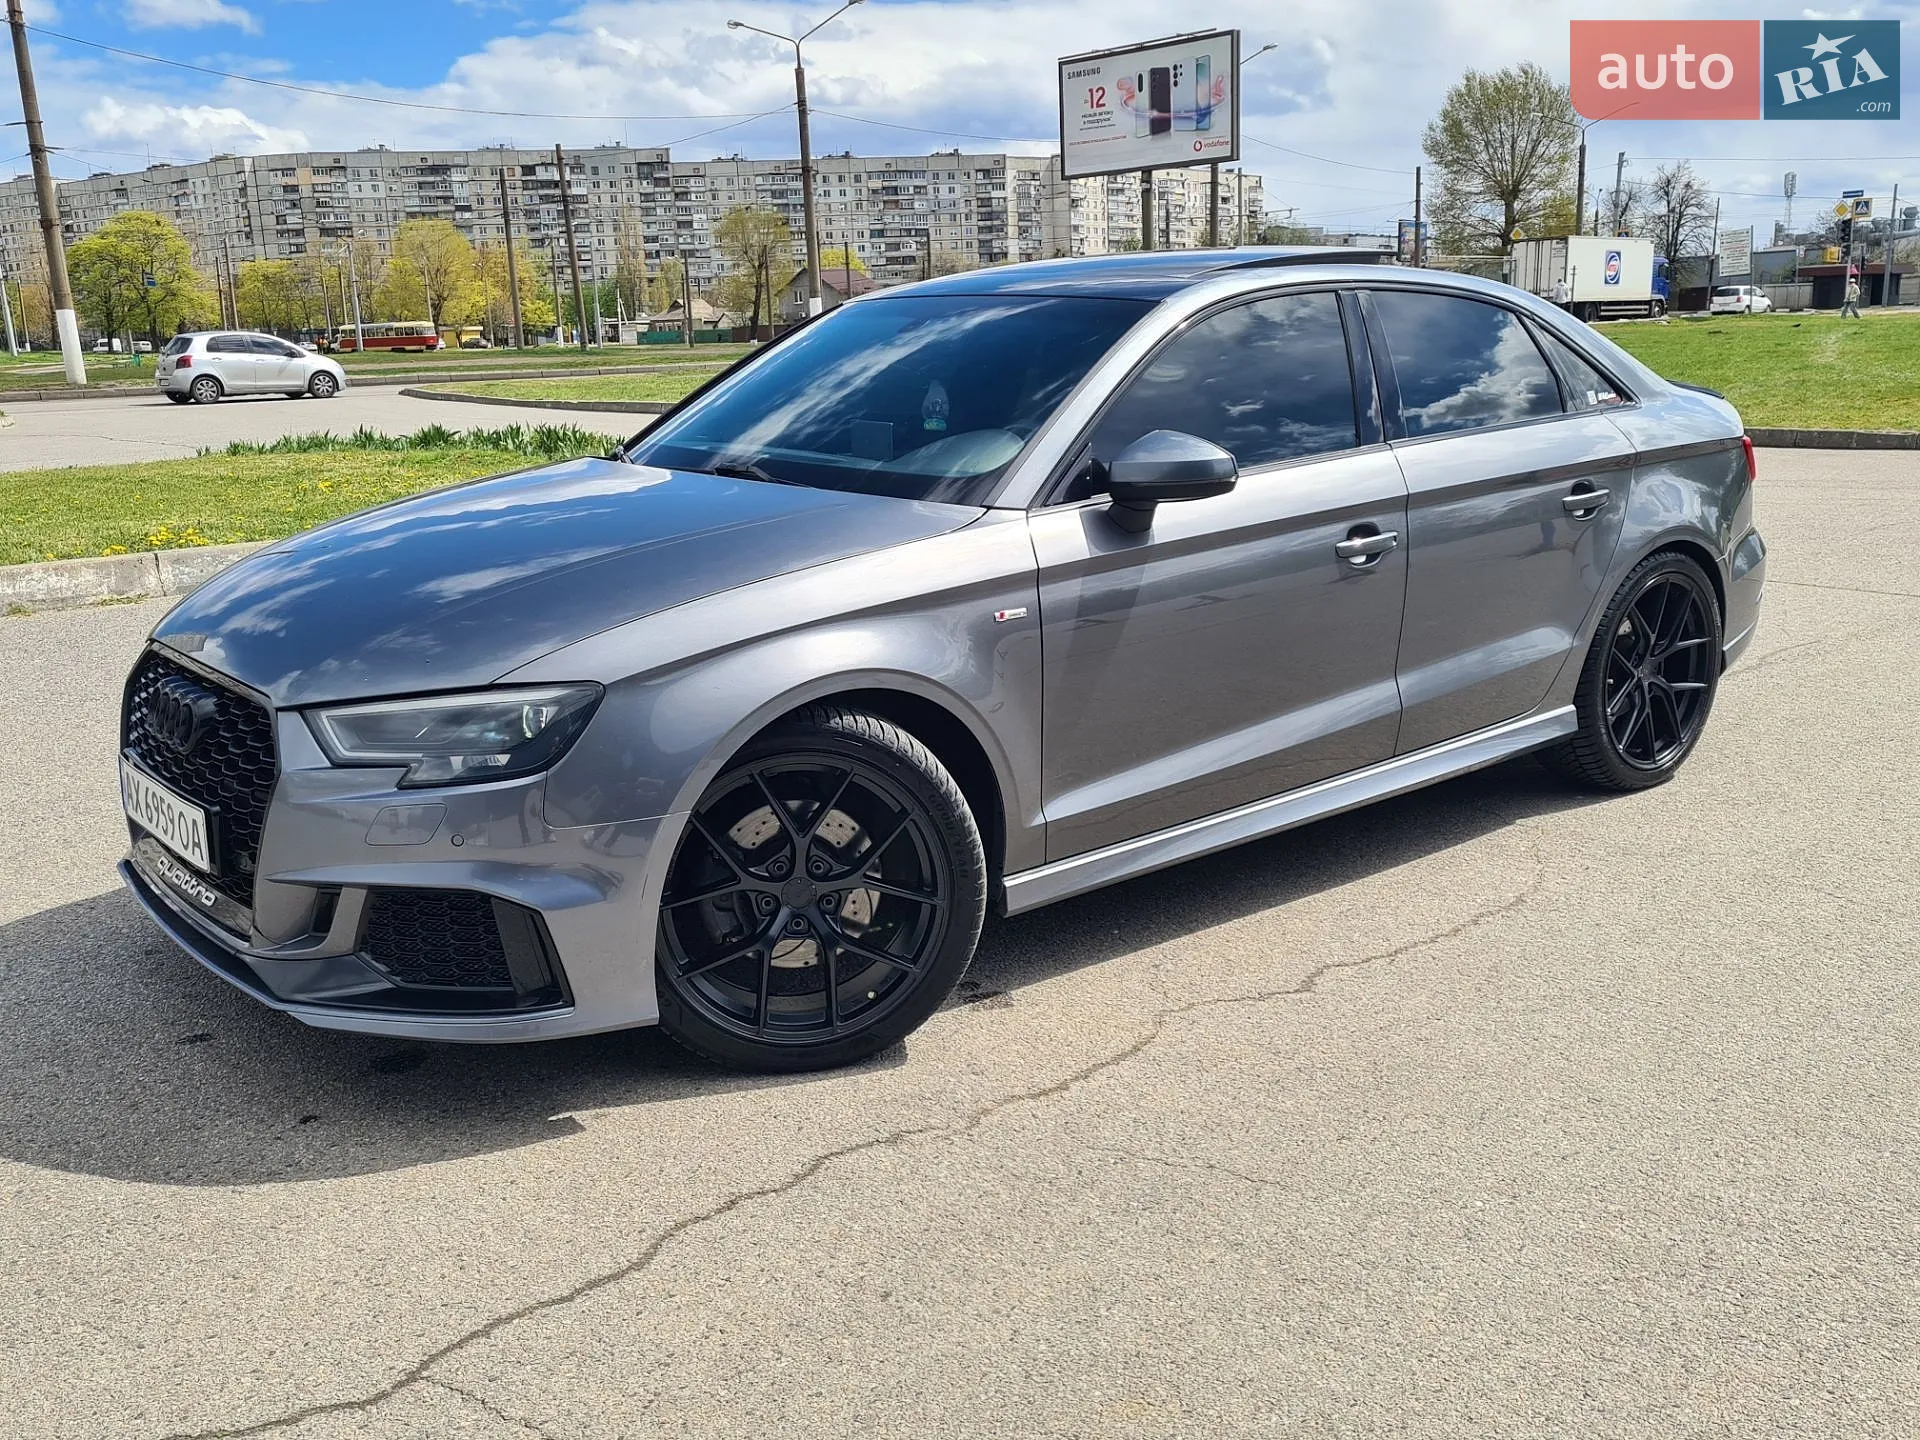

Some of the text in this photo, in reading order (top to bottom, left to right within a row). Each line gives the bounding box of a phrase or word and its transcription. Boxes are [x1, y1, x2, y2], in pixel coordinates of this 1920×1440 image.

[1067, 66, 1101, 80] SAMSUNG
[1203, 139, 1230, 148] vodafone
[126, 771, 204, 862] AX 6959 OA
[158, 855, 216, 907] quattro
